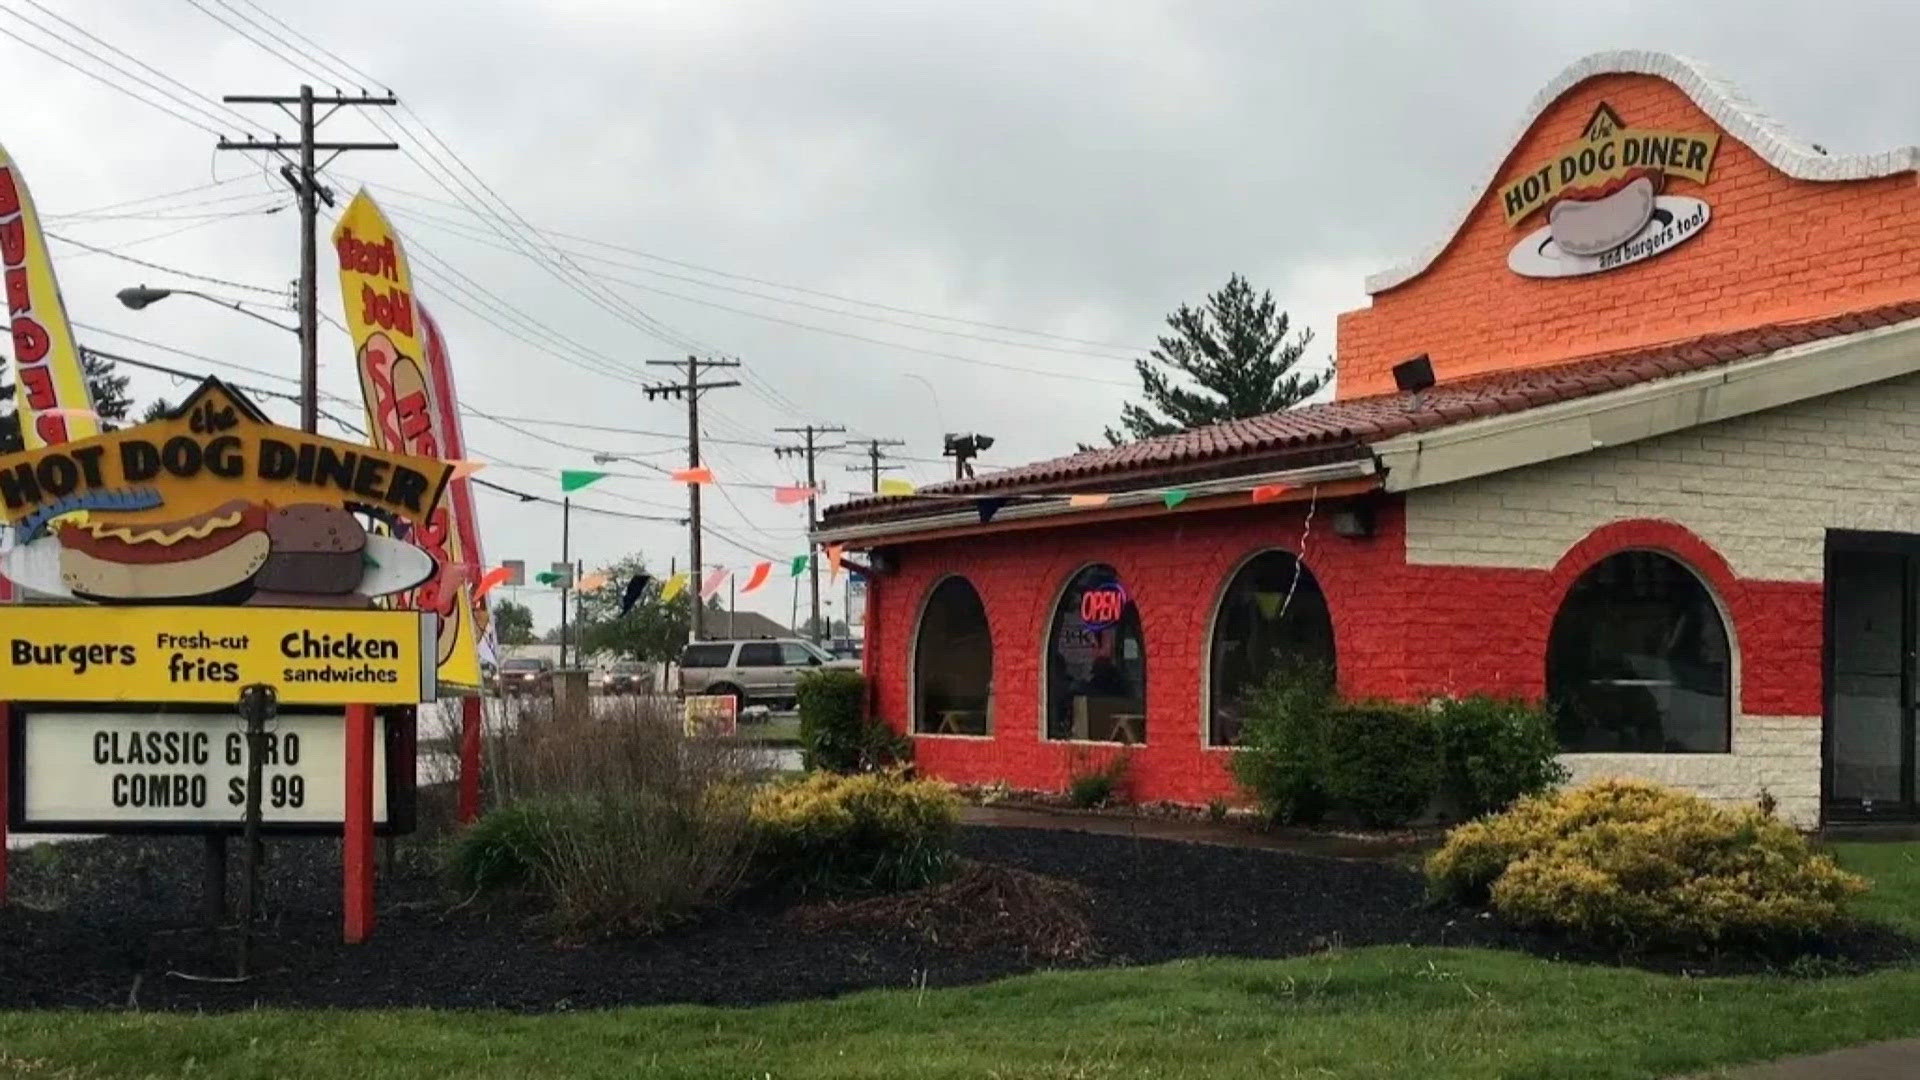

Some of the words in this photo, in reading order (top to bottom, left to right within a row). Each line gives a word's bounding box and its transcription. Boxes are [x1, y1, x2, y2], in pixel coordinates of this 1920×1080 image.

[1591, 116, 1612, 143] the
[1504, 165, 1552, 216] HOT
[1560, 141, 1615, 185] DOG
[1622, 137, 1708, 172] DINER
[1599, 245, 1622, 268] and
[1624, 226, 1674, 258] burgers
[1677, 203, 1704, 235] too!
[189, 400, 238, 434] the
[0, 446, 104, 508] HOT
[119, 437, 242, 482] DOG
[258, 438, 430, 512] DINER
[1082, 591, 1121, 622] OPEN
[11, 639, 137, 674] Burgers
[157, 633, 249, 650] Fresh-cut
[280, 630, 398, 660] Chicken
[168, 653, 240, 683] fries
[283, 664, 398, 683] sandwiches
[94, 731, 209, 766] CLASSIC
[226, 732, 299, 766] GRO
[112, 774, 206, 808] COMBO
[228, 774, 304, 808] $99
